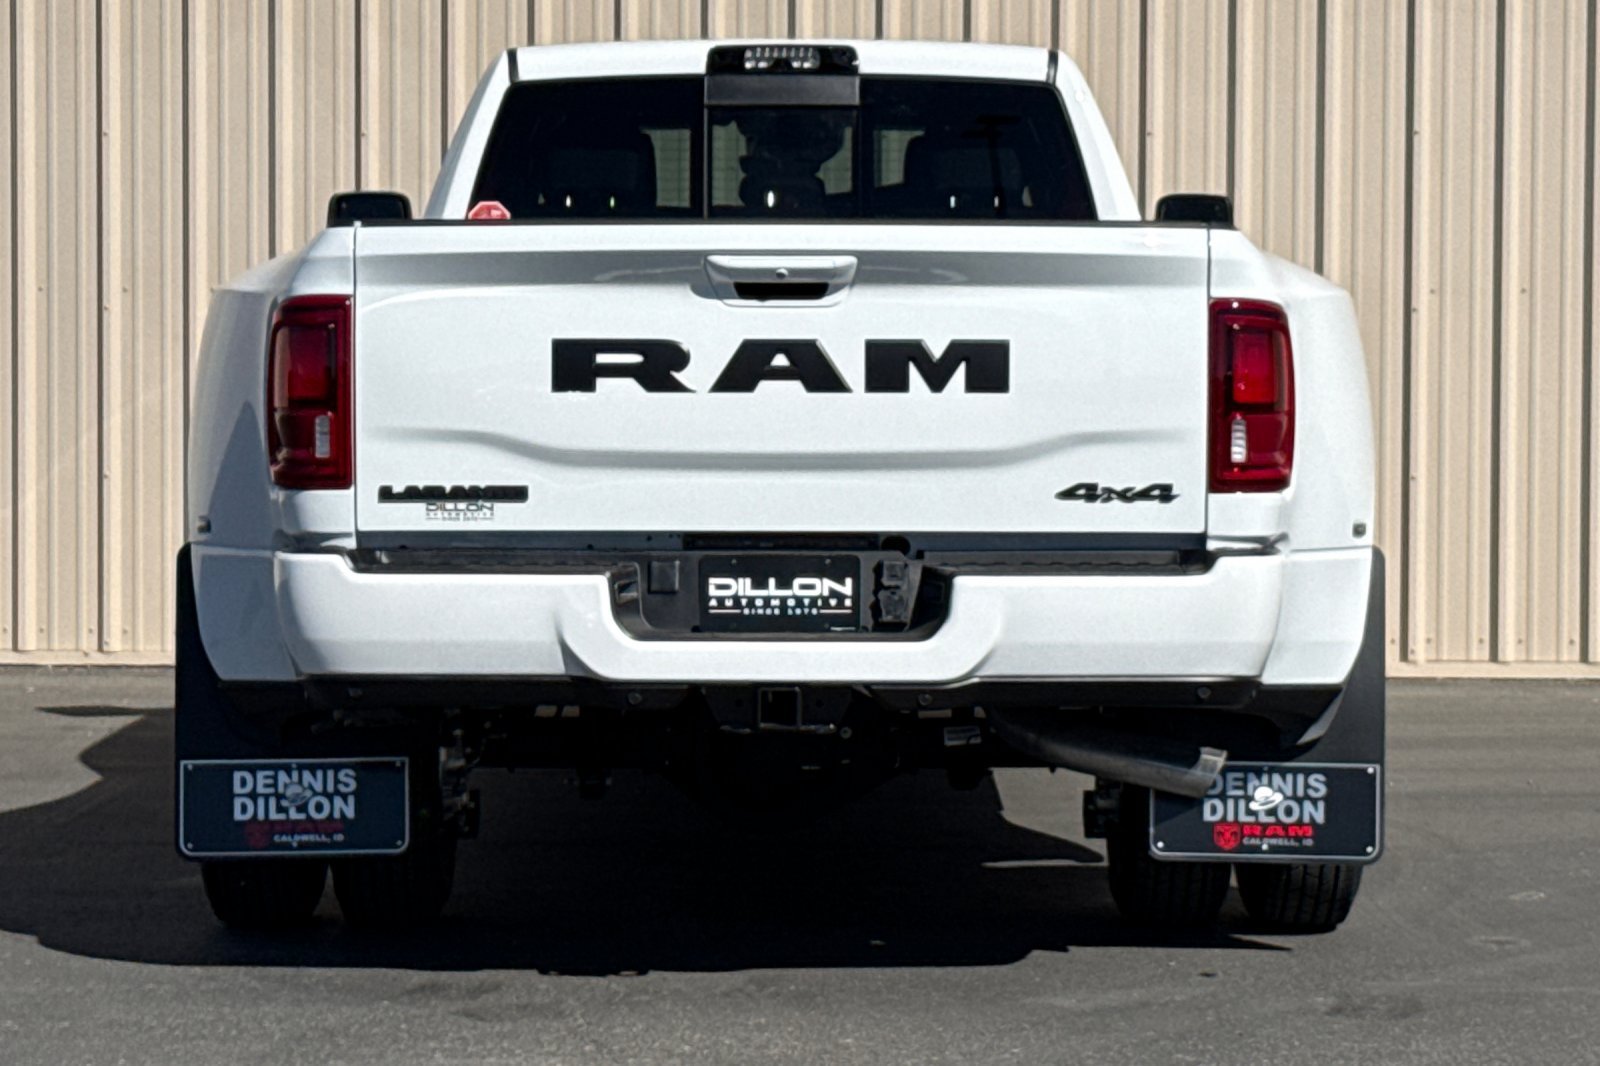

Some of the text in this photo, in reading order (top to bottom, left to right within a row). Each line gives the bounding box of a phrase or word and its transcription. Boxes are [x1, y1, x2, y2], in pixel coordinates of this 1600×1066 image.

[551, 338, 1010, 394] RAM
[1054, 482, 1180, 503] 4x4
[708, 577, 852, 597] DILLON
[708, 598, 852, 607] AUTOMOTIVE
[233, 768, 357, 795] DENNIS
[233, 795, 356, 821] DILLON
[1203, 799, 1325, 824] DILLON
[1242, 825, 1314, 837] RAM
